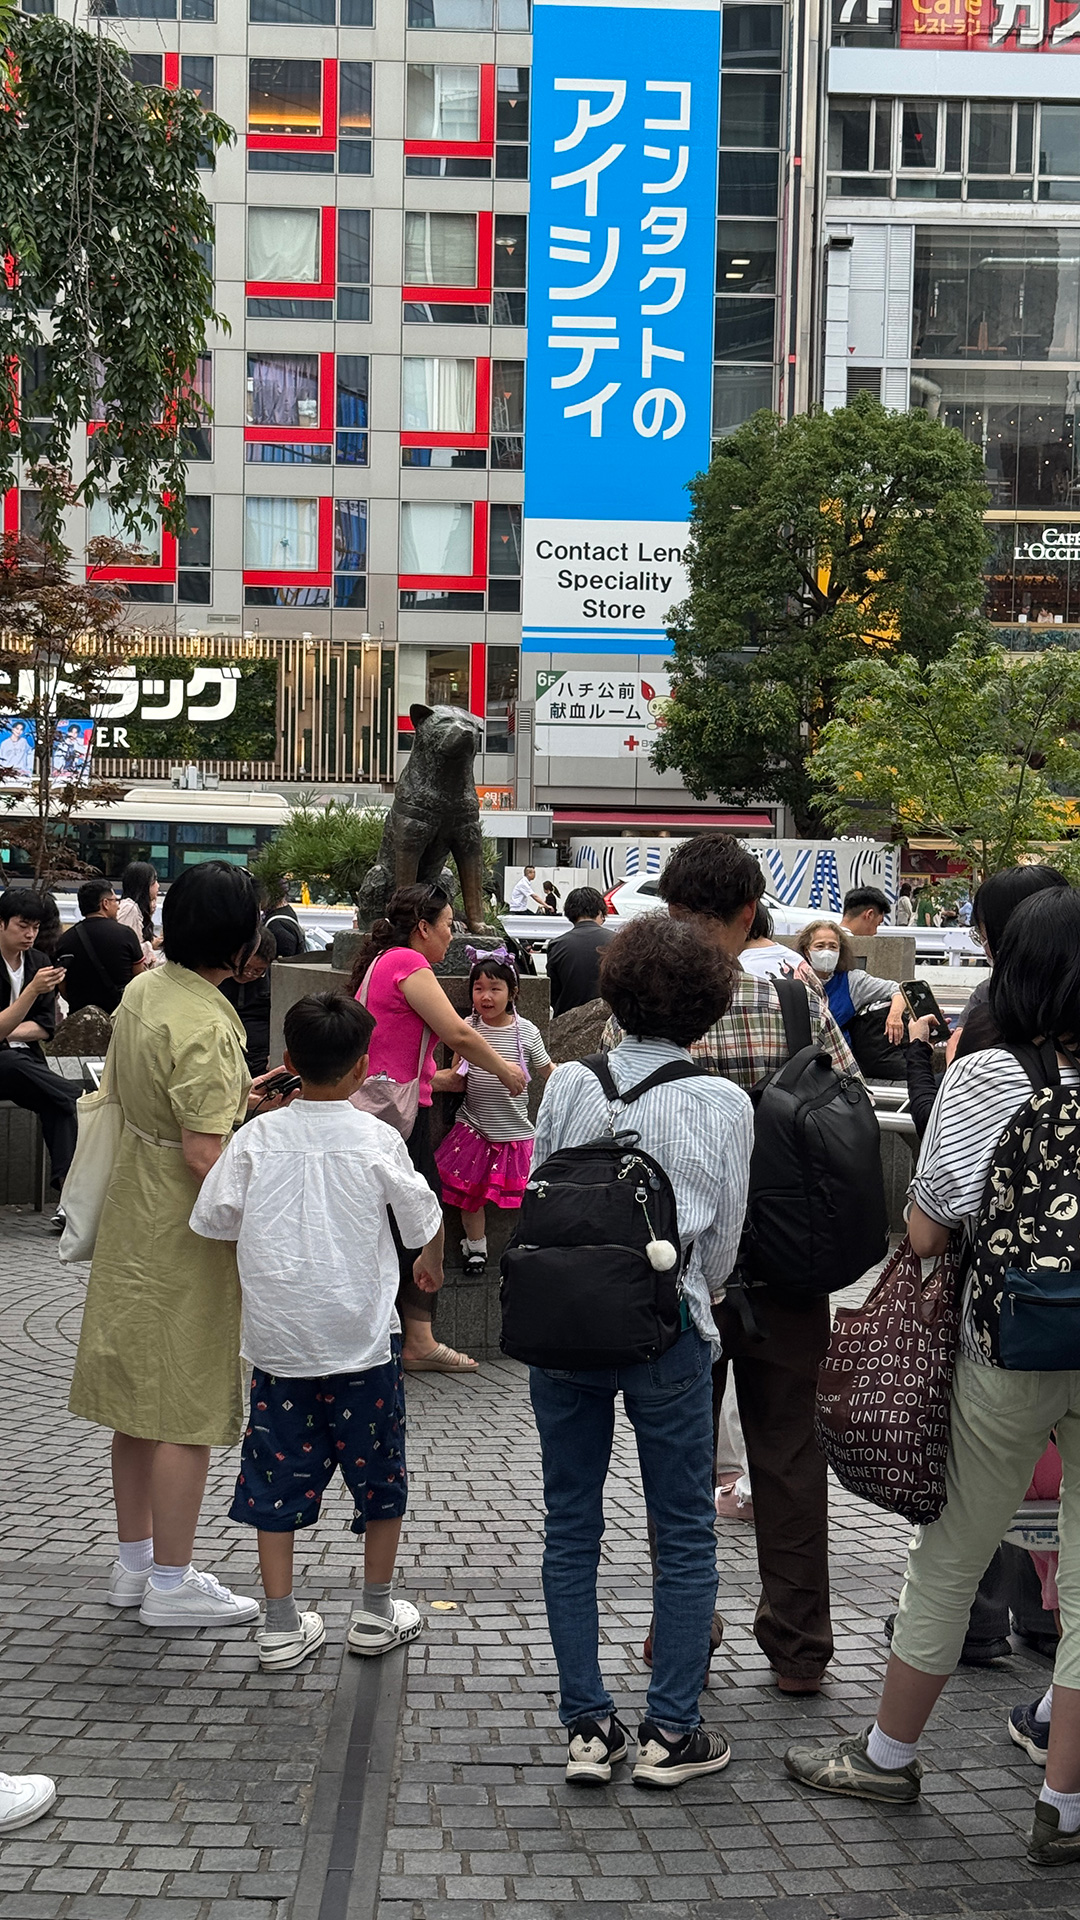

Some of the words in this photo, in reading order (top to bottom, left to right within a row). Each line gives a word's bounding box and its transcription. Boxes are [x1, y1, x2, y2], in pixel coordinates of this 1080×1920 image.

[914, 18, 981, 36] レストラン
[548, 77, 627, 438] アイシティ
[633, 80, 692, 441] コンタクトの
[536, 540, 628, 561] Contact
[557, 569, 672, 593] Speciality
[582, 599, 646, 619] Store
[537, 672, 556, 686] 6F
[557, 681, 635, 699] ハチ公前
[550, 702, 641, 720] 献血ルーム
[851, 1409, 910, 1424] UNITED
[846, 1465, 918, 1485] BENETTON.
